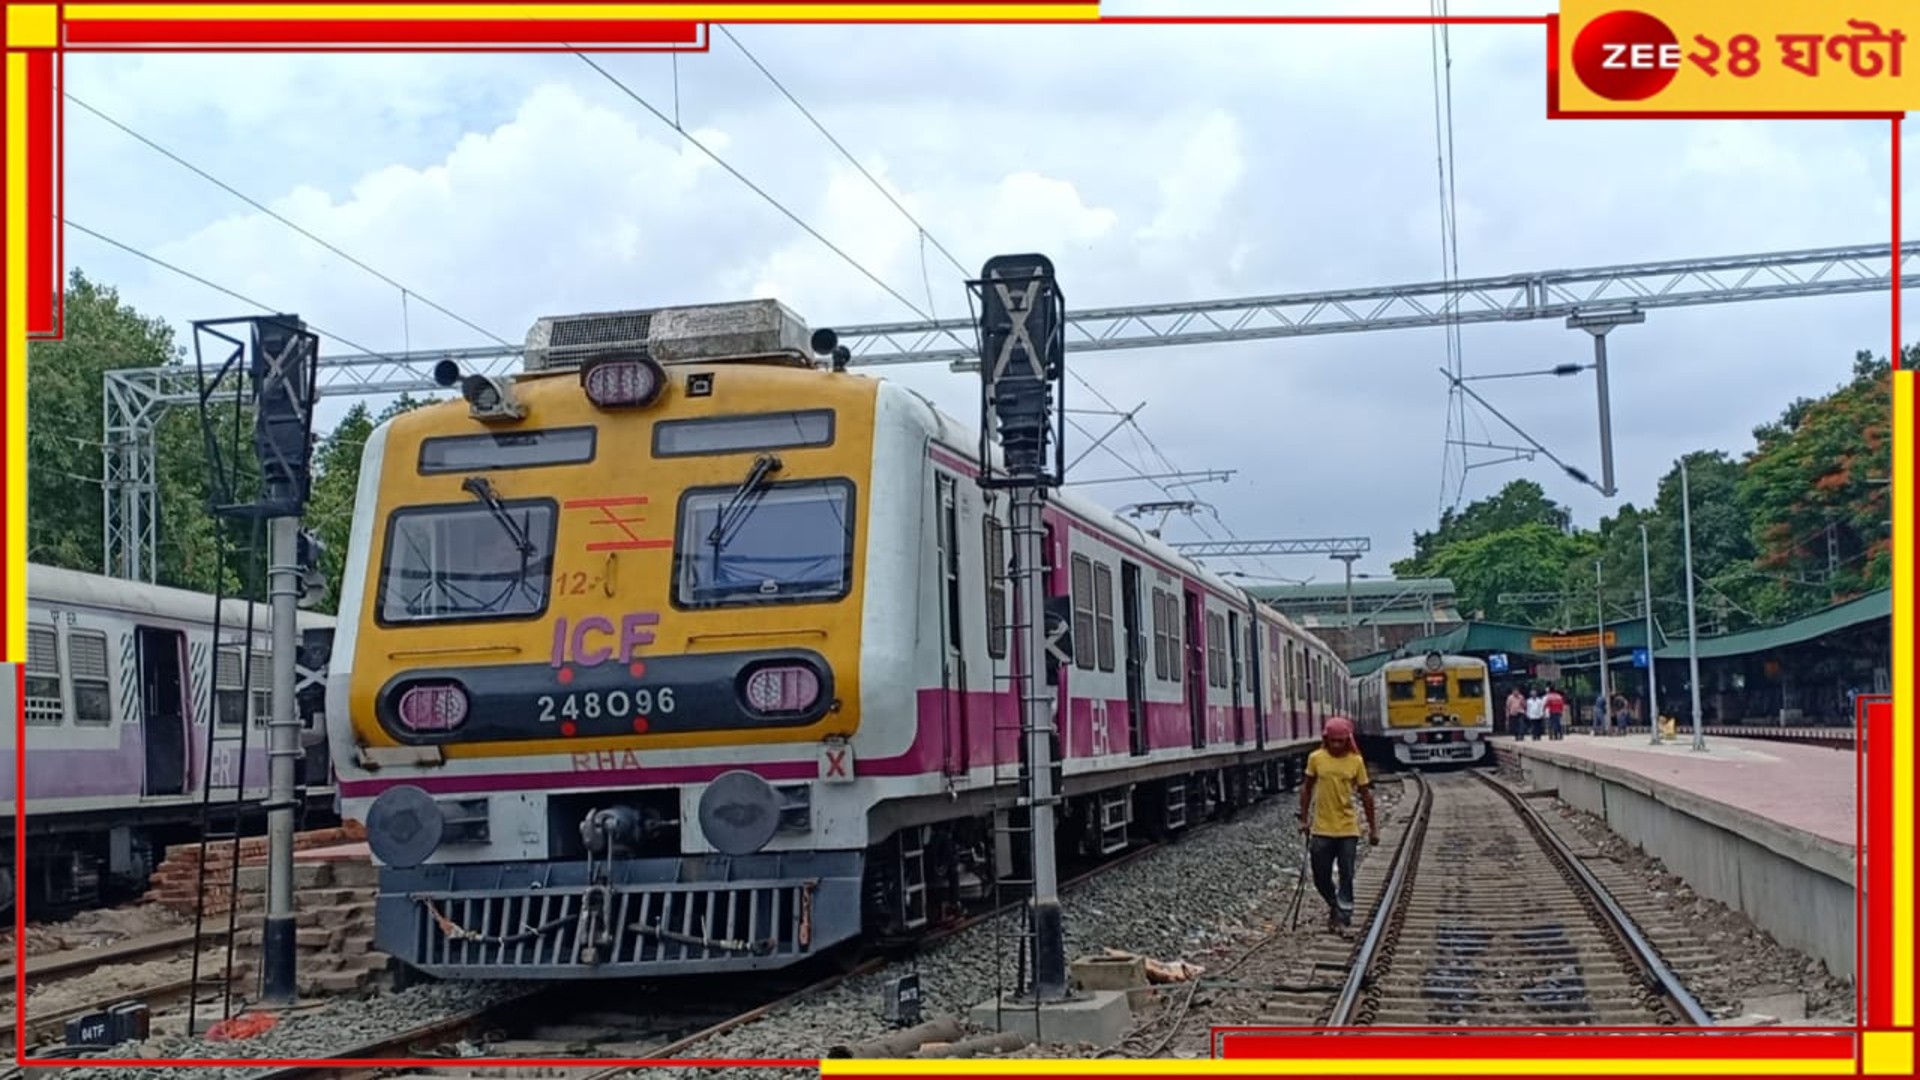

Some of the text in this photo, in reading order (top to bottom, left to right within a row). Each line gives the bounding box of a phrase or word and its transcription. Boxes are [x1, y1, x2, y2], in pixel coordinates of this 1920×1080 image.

[551, 612, 660, 668] ICF
[537, 687, 675, 722] 248096
[572, 748, 641, 771] RHA
